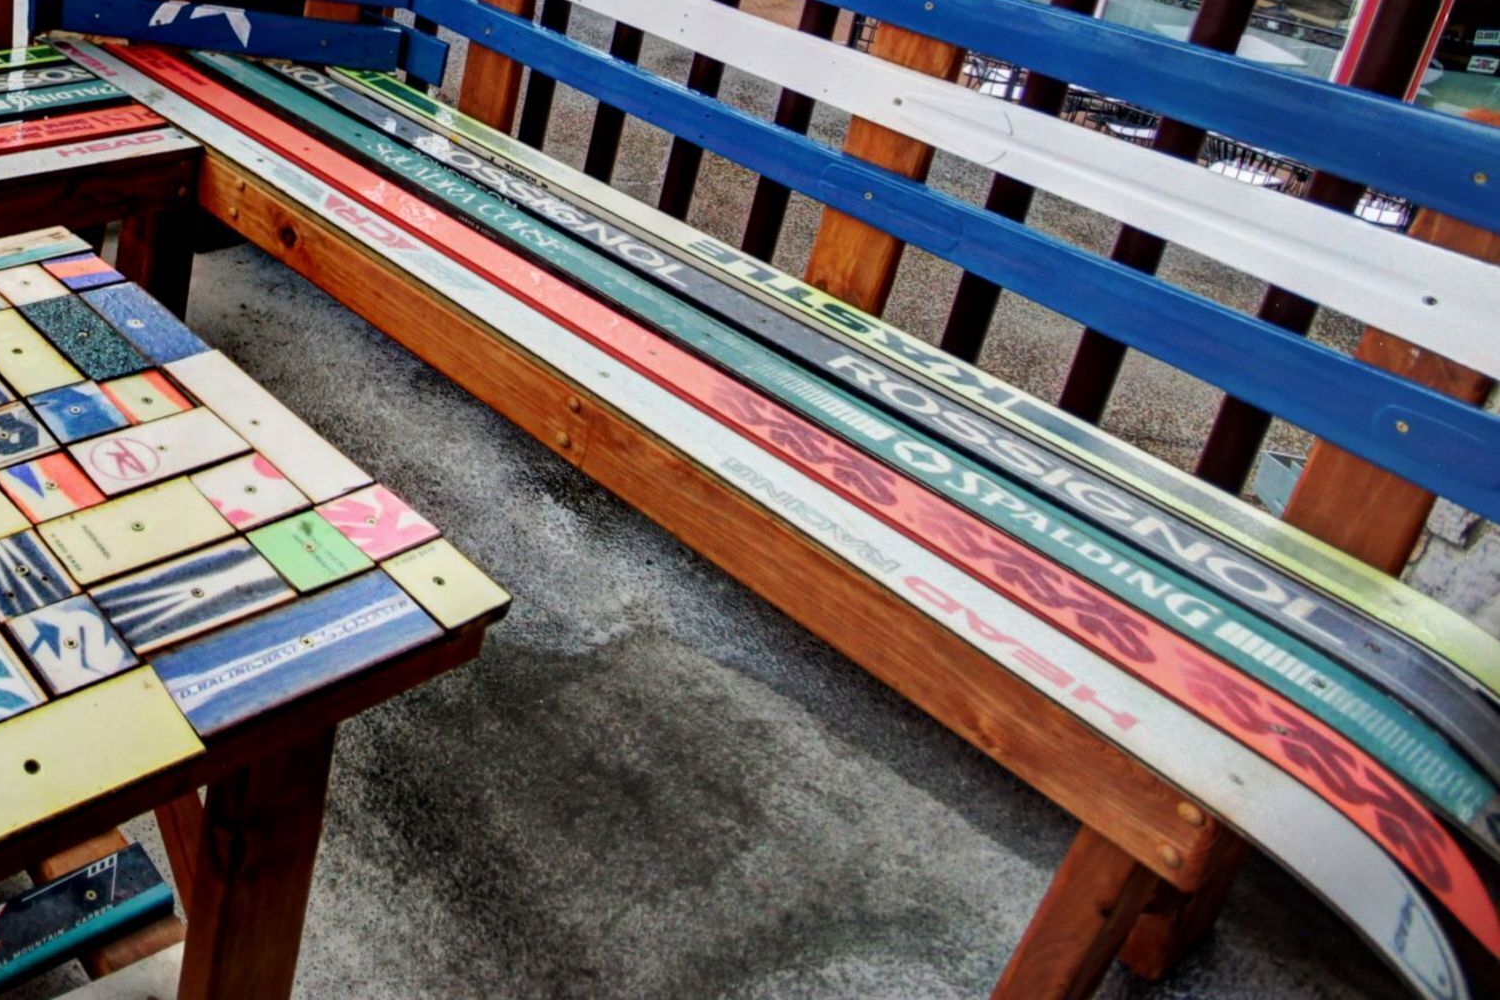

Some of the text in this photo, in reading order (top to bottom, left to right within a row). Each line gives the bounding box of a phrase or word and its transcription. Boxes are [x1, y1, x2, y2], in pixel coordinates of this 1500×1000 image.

[56, 132, 164, 158] HEAD
[687, 239, 1014, 408] KASTLE
[827, 355, 1345, 645] ROSSIGNOL
[945, 470, 1226, 630] SPALDING
[720, 456, 902, 574] RACING
[902, 574, 1140, 732] HEAD
[12, 927, 66, 960] MOUNTAIN
[74, 902, 115, 928] CARBON
